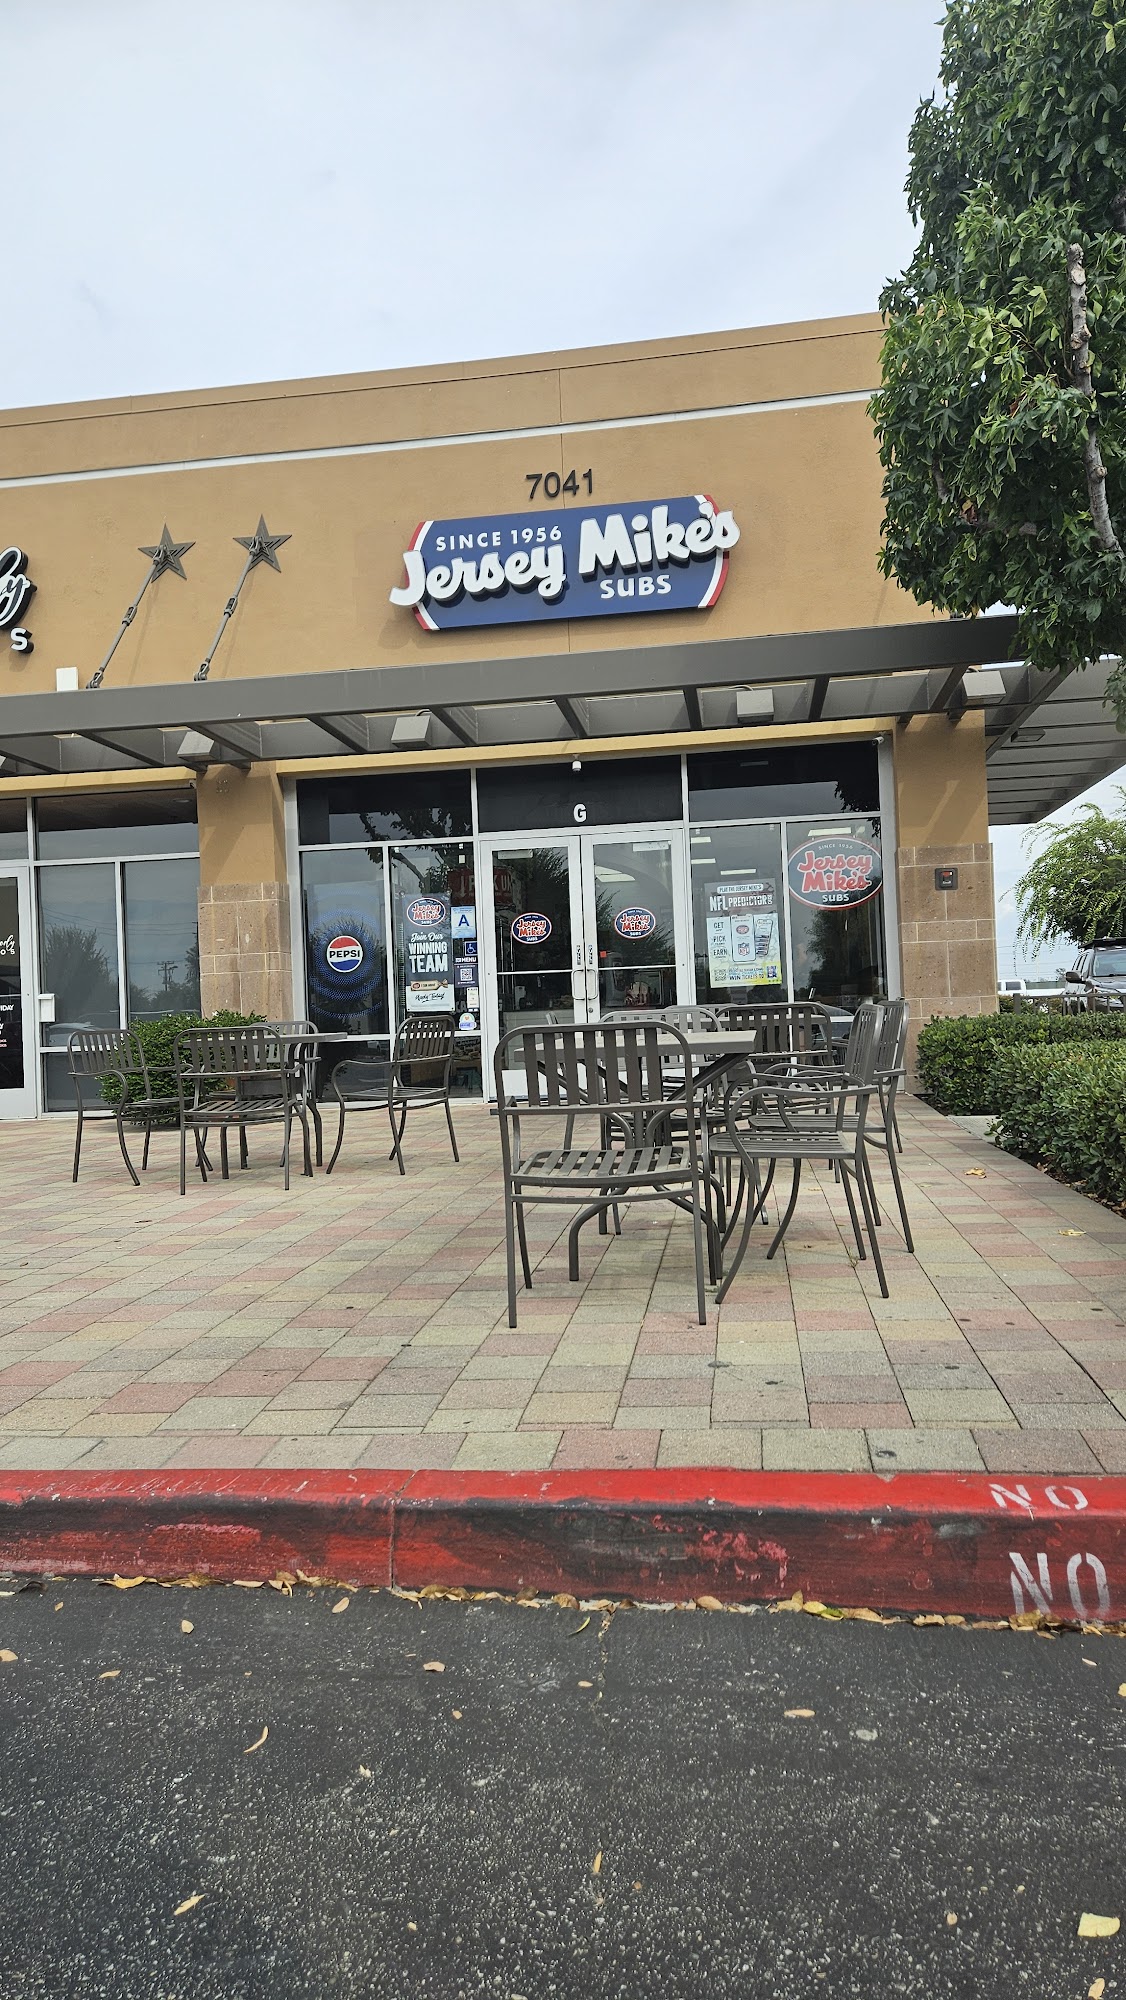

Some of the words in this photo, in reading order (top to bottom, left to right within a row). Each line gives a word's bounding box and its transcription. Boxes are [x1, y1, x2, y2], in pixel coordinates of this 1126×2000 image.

[525, 468, 594, 499] 7041
[436, 531, 502, 551] SINCE
[511, 525, 562, 545] 1956
[389, 543, 567, 607] Jersey
[578, 501, 742, 576] Mike's
[600, 574, 672, 599] SUBS
[573, 803, 587, 822] G
[797, 850, 873, 877] Jersey
[801, 869, 873, 894] Mike's
[709, 895, 728, 912] NFL
[728, 894, 767, 908] PREDICTOR
[822, 893, 850, 902] SUBS
[412, 903, 441, 913] Jersey
[458, 914, 470, 927] A
[516, 918, 547, 929] Jersey
[620, 913, 650, 924] Jersey
[411, 931, 427, 942] Join
[329, 949, 360, 959] PEPSI
[408, 942, 448, 955] WINNING
[408, 954, 449, 973] TEAM
[0, 1004, 15, 1012] IDAY
[989, 1483, 1089, 1511] NO
[1009, 1552, 1111, 1622] NO
